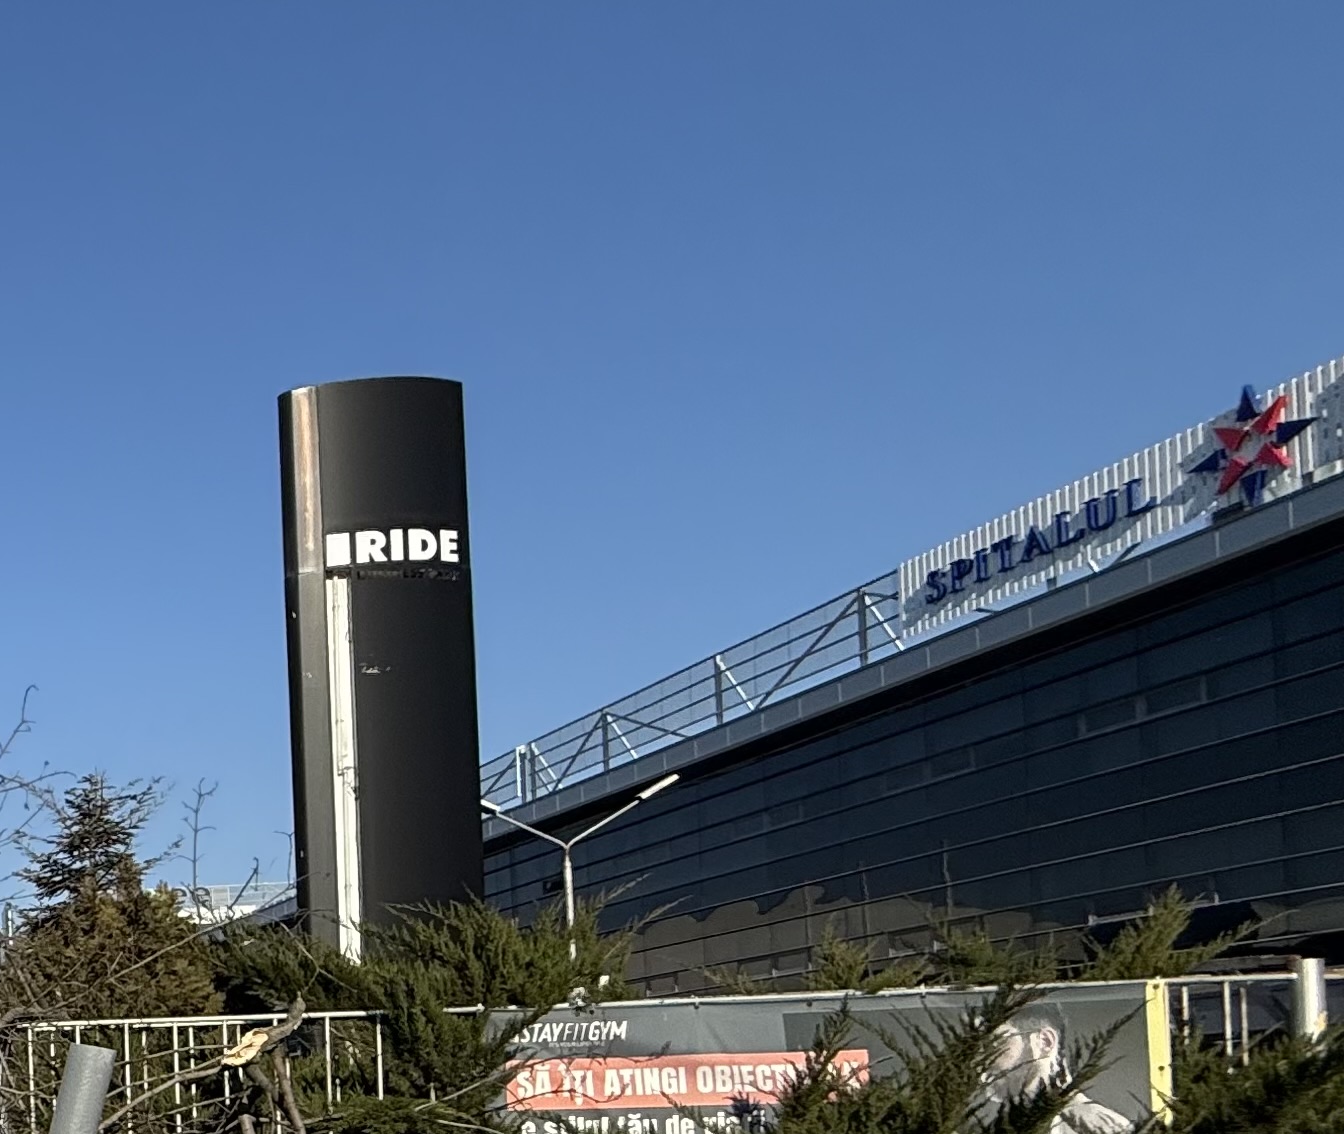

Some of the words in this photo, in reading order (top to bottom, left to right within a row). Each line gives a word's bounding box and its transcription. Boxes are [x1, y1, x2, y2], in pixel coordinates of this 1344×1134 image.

[355, 528, 459, 564] RIDE
[925, 478, 1158, 604] SPITALUL
[520, 1020, 628, 1043] STAYFITGYM
[604, 1066, 688, 1098] ATINGI
